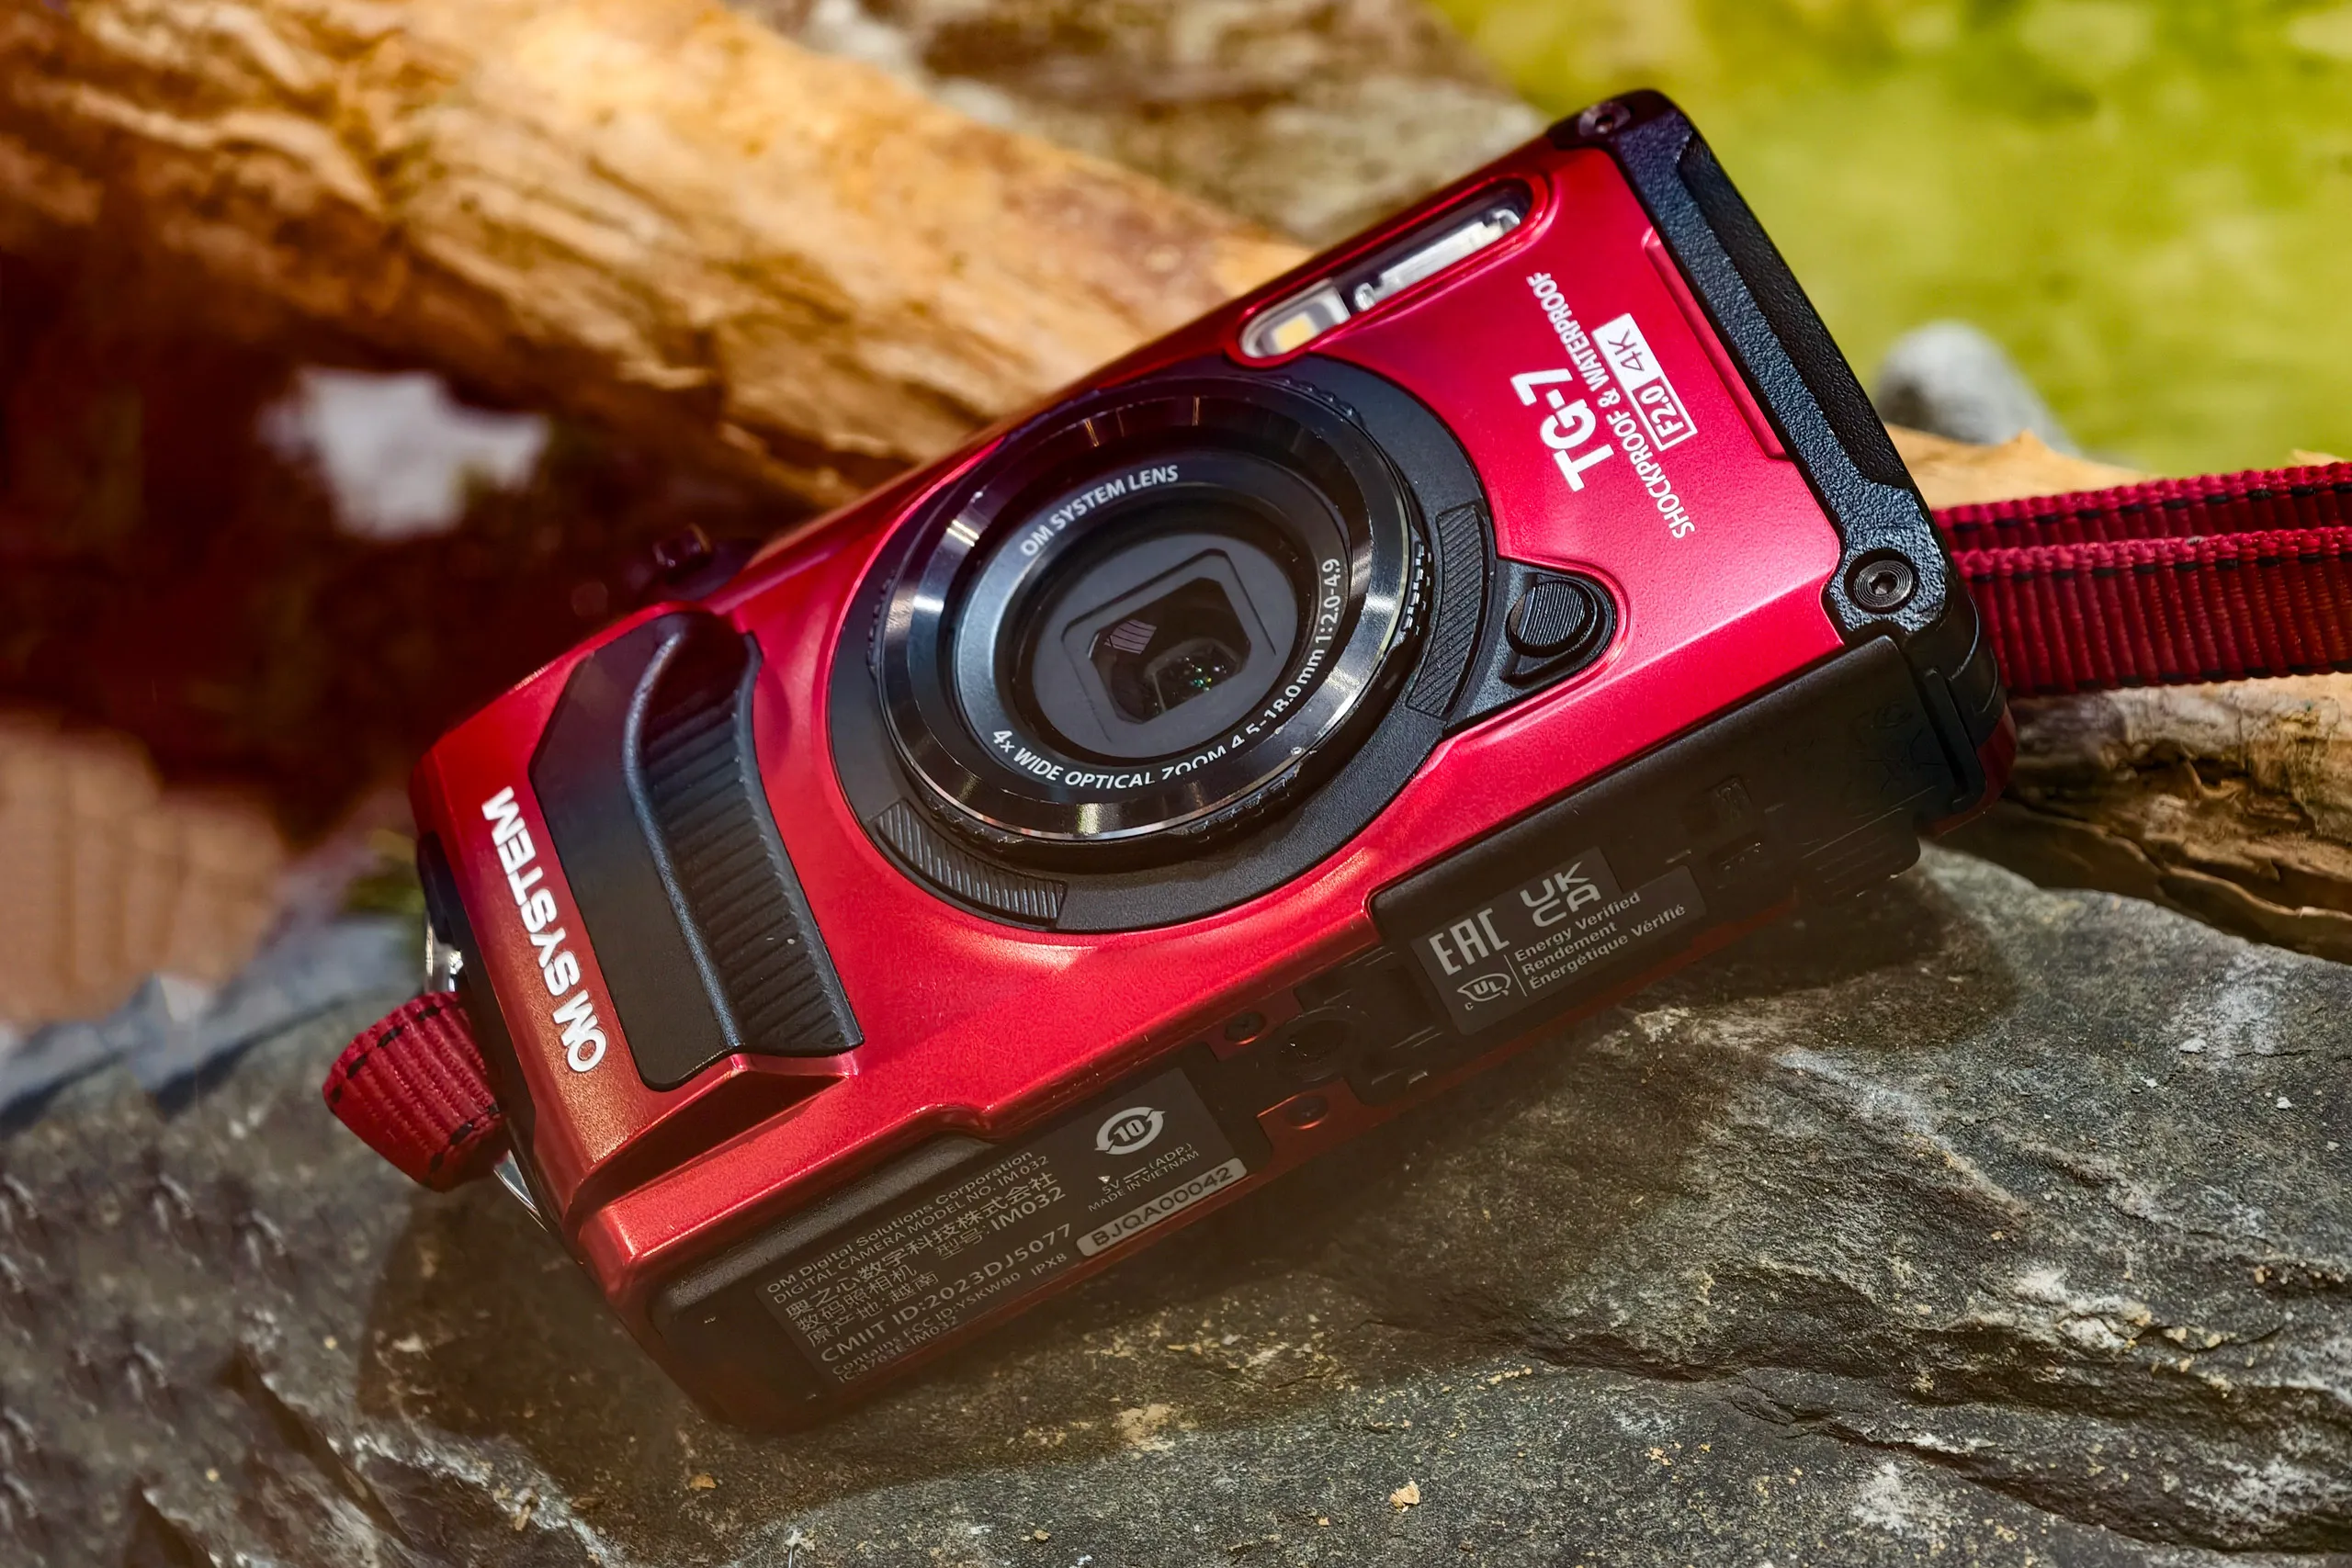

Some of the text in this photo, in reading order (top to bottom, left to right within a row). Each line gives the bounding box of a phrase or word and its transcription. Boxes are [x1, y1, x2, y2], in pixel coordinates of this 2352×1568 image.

[1607, 328, 1645, 372] 4K
[1510, 367, 1615, 492] TG-7
[1526, 272, 1696, 539] SHOCKPROOF & WATERPROOF
[1640, 384, 1685, 439] F2.0
[1020, 463, 1180, 558] OM SYSTEM LENS
[992, 728, 1015, 754] 4x
[1012, 746, 1063, 782] WIDE
[1064, 769, 1156, 790] OPTICAL
[1315, 558, 1341, 644] 1:2.0-4.9
[481, 785, 608, 1073] OM SYSTEM
[1429, 907, 1510, 976] EAC
[1514, 891, 1641, 963] Energy Verified
[1521, 920, 1618, 976] Rendement
[1528, 903, 1686, 990] Énergétique Vérifié
[1473, 977, 1503, 996] UL
[1114, 1119, 1146, 1143] 10
[1088, 1150, 1200, 1213] MADE IN VIETNAM
[766, 1151, 1033, 1294] OM Digital Solutions Corporation
[773, 1269, 837, 1304] DIGITAL
[838, 1231, 906, 1269] CAMERA
[908, 1200, 966, 1234] MODEL
[967, 1186, 997, 1203] NO.
[786, 1171, 1057, 1321] 奥之心数字科技株式会社
[796, 1264, 918, 1332] 数码照相机
[820, 1223, 1070, 1362] CMIIT ID:2023DJ5077
[1030, 1252, 1068, 1277] IPX8
[831, 1337, 902, 1375] Contains
[903, 1317, 933, 1337] FCC
